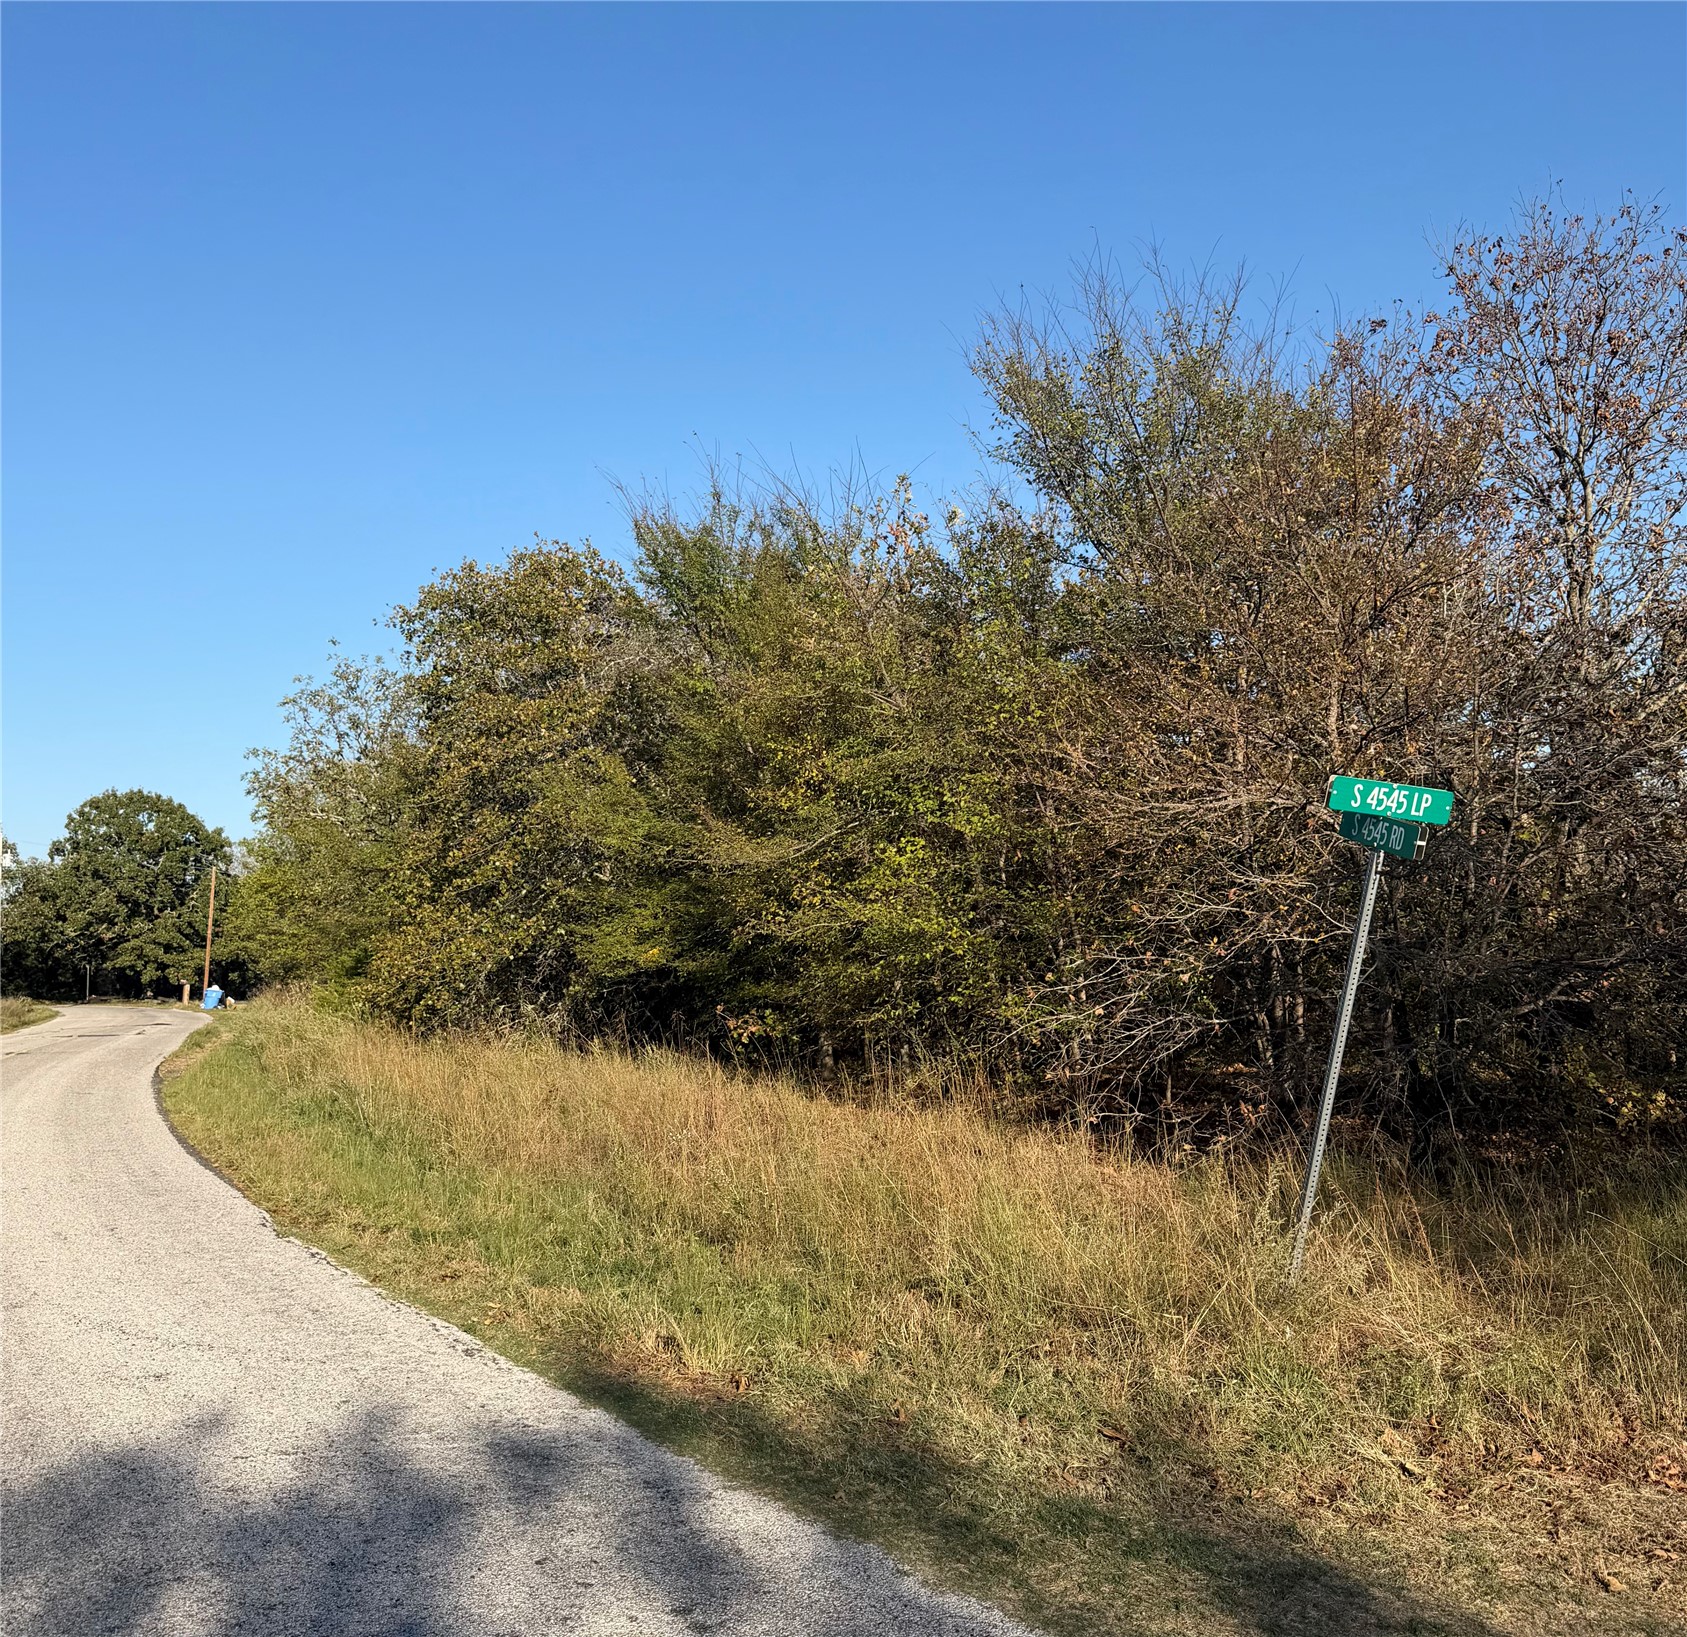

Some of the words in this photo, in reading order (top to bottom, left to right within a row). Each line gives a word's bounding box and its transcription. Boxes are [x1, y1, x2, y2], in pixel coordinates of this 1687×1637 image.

[1351, 784, 1363, 808] S
[1367, 786, 1409, 814] 4545
[1411, 792, 1432, 816] LP
[1352, 814, 1360, 836] S
[1362, 817, 1389, 845] 4545
[1389, 825, 1405, 850] RD
